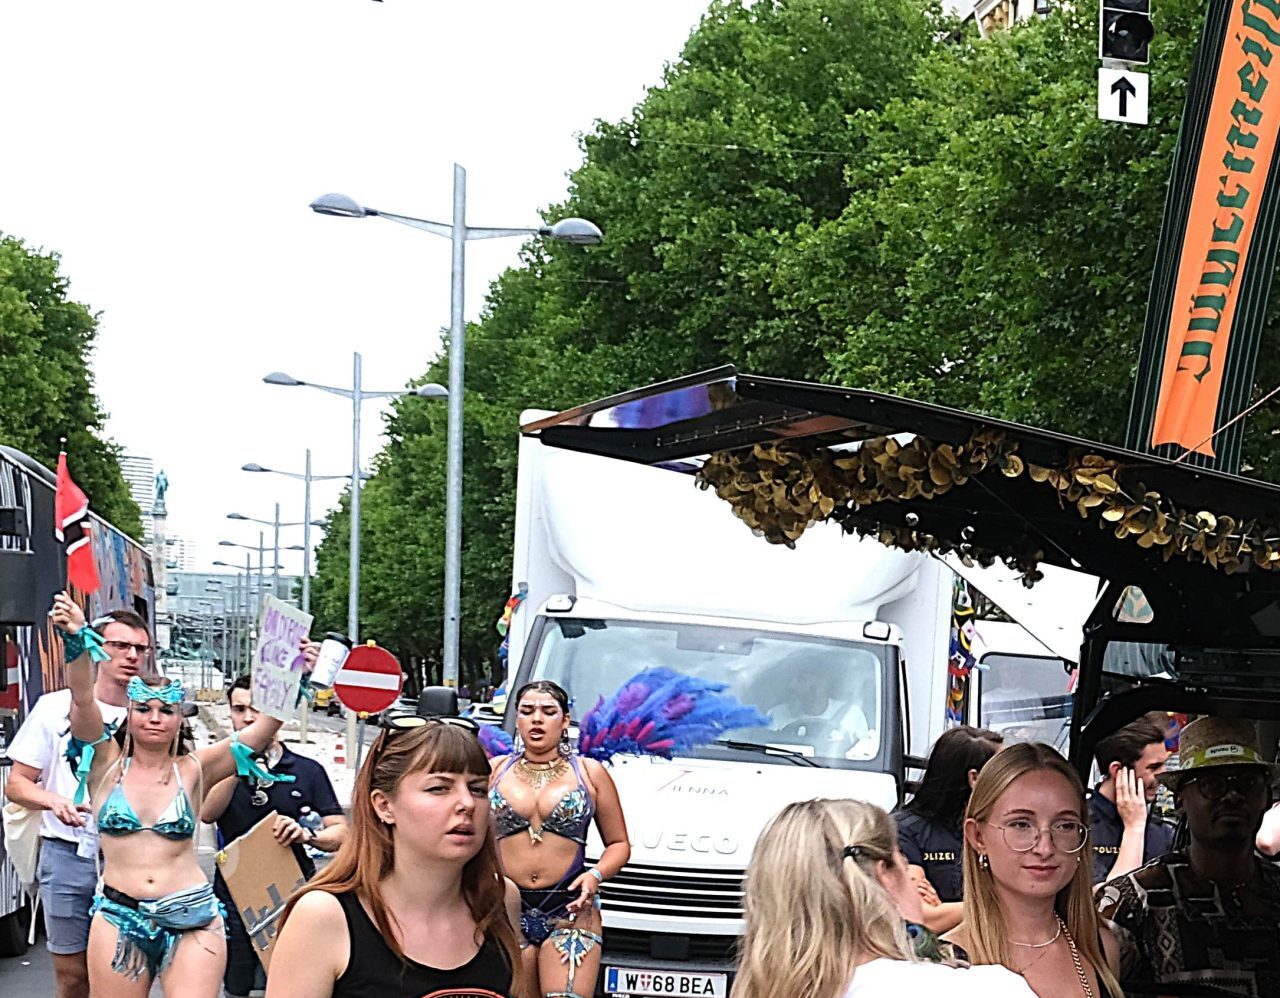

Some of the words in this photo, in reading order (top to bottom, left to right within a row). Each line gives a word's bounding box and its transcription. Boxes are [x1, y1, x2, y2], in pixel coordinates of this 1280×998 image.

[626, 973, 639, 991] W
[652, 975, 675, 993] 68
[680, 976, 715, 996] BEA
